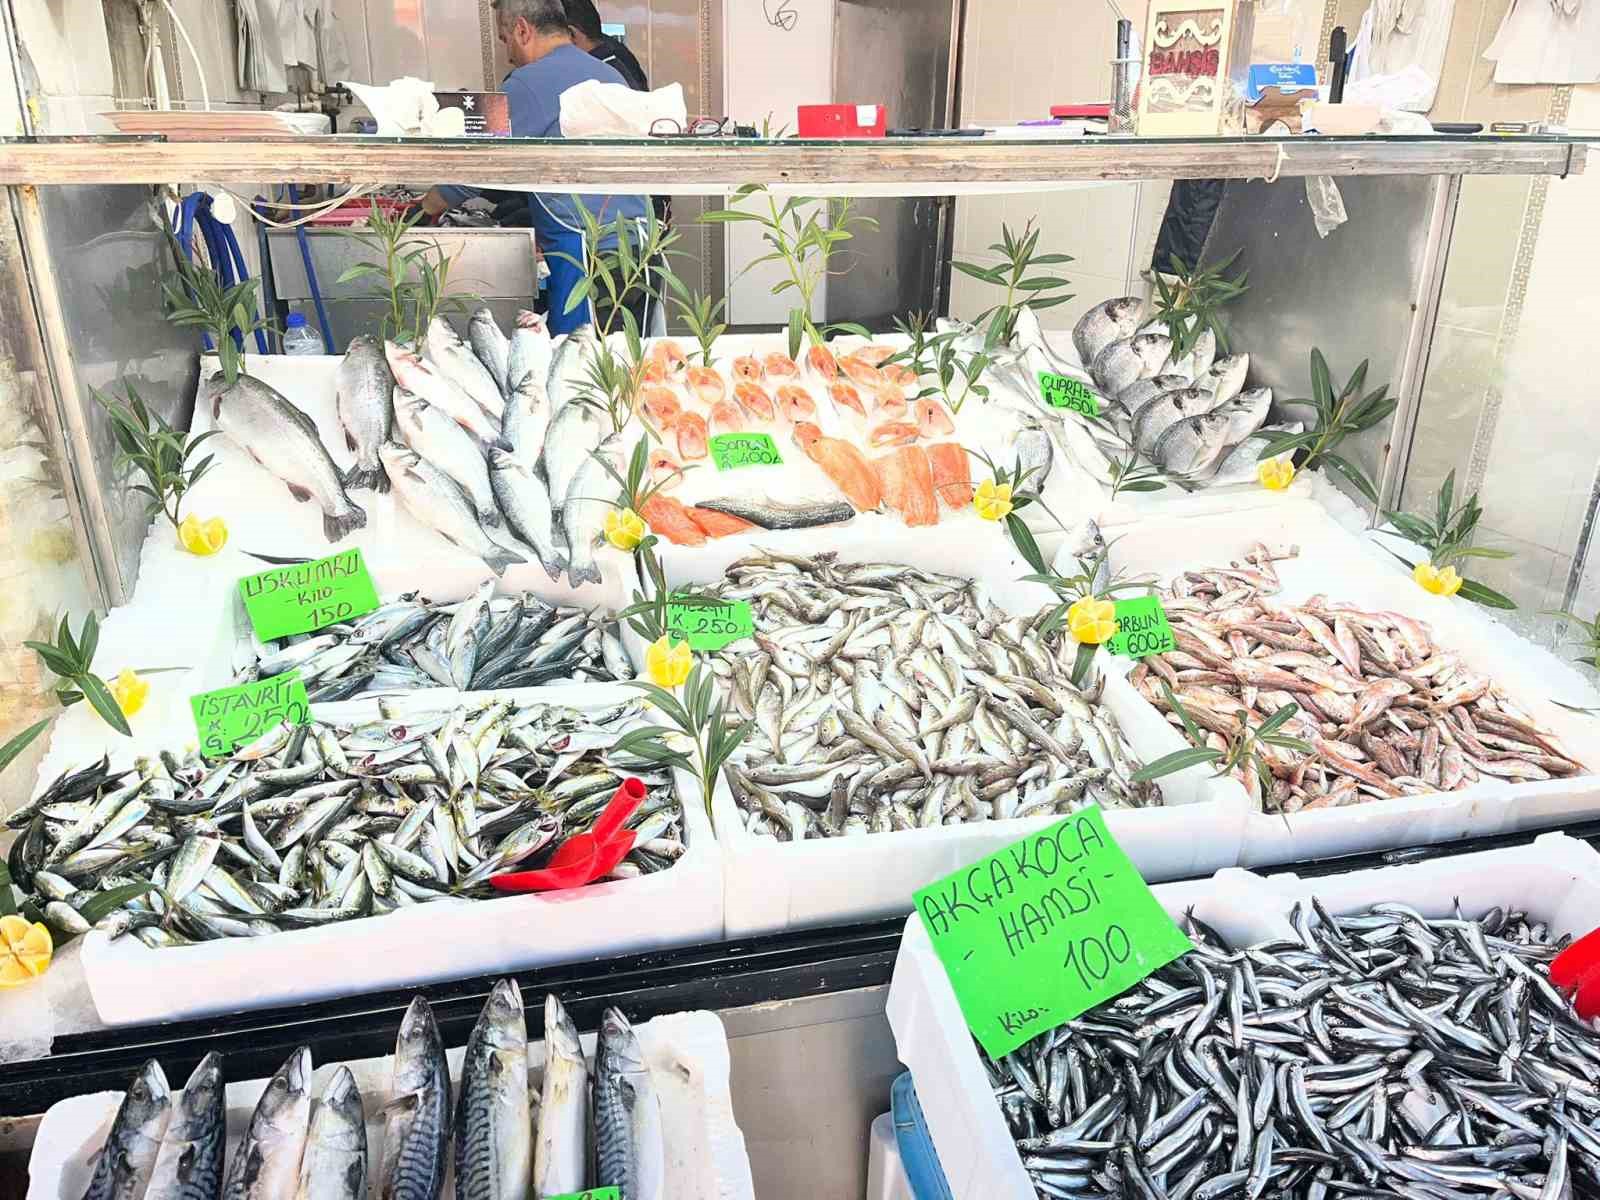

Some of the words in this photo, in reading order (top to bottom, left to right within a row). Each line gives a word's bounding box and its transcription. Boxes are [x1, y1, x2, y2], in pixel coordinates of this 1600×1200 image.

[245, 552, 359, 597] USKUMRU
[306, 601, 353, 627] 150
[1064, 924, 1131, 991] 100
